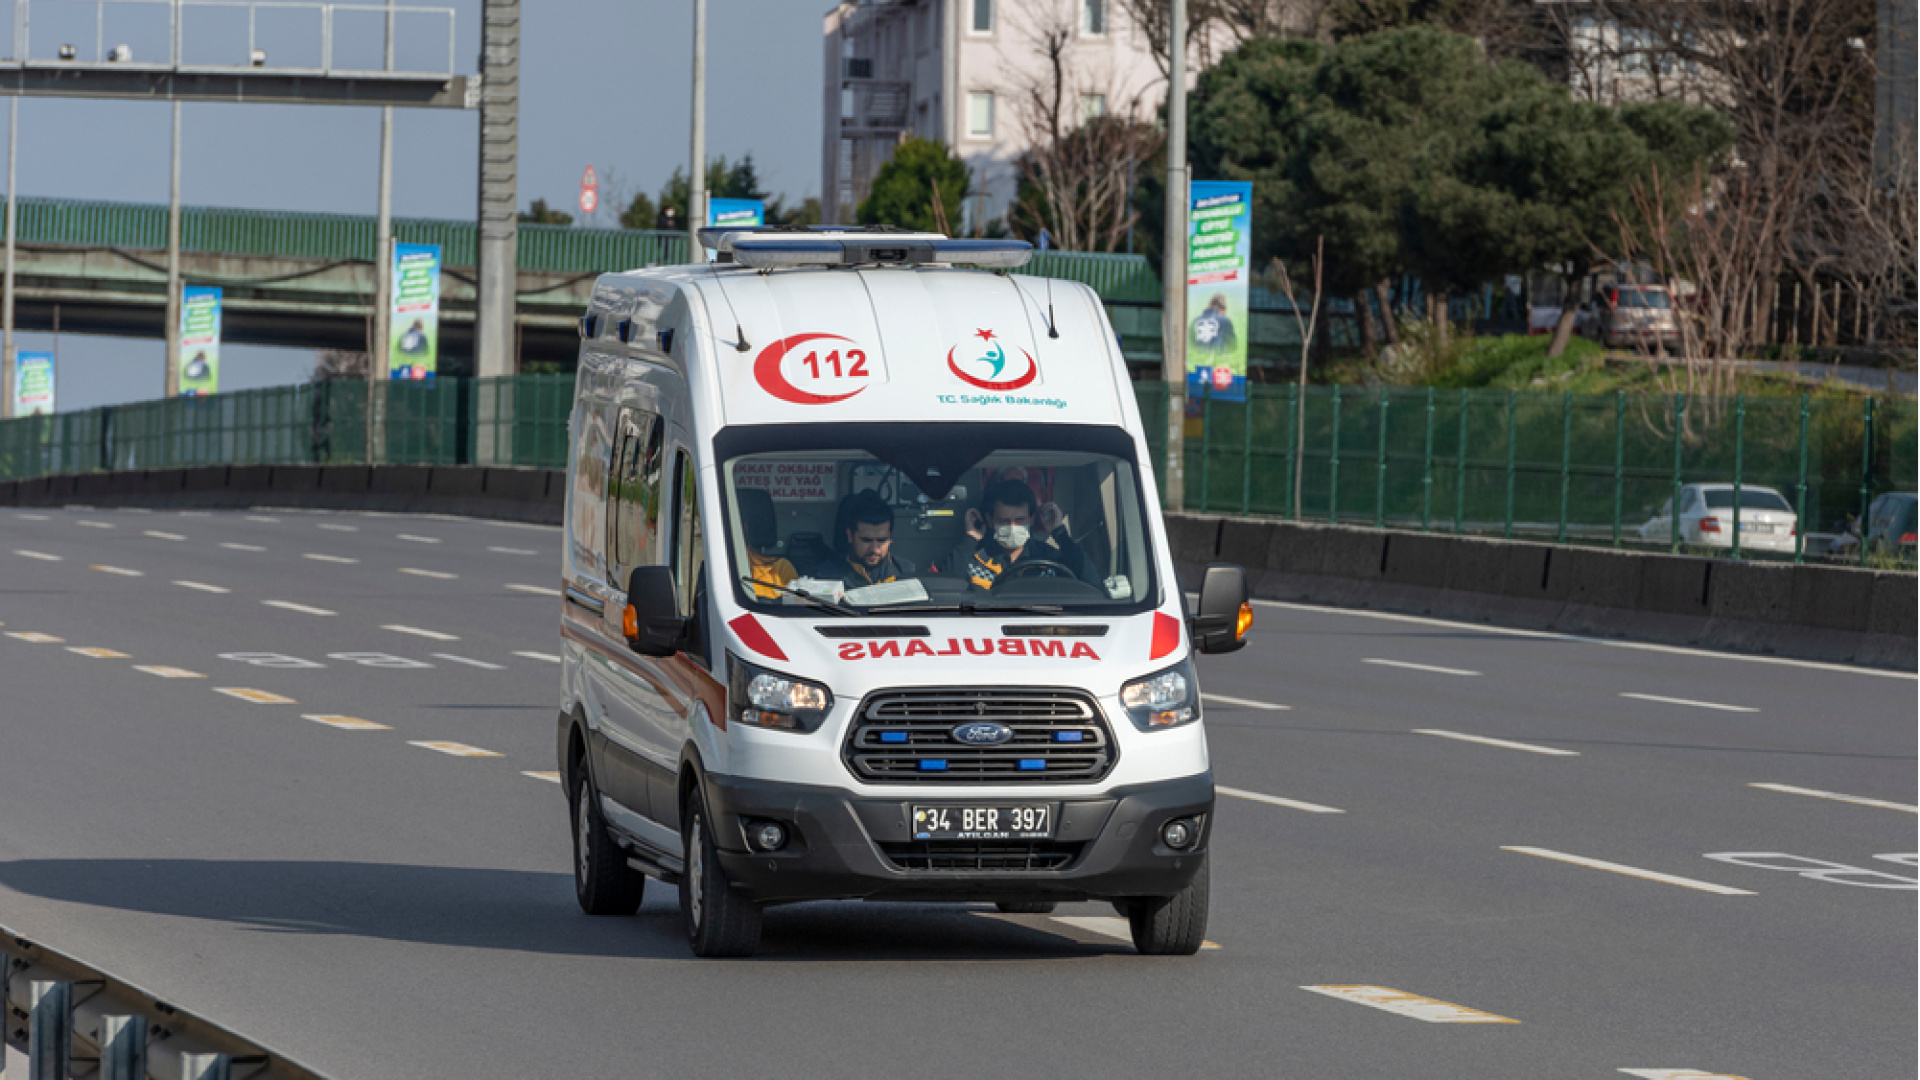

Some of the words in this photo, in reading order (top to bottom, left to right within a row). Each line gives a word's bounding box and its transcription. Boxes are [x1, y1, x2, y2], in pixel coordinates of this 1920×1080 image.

[802, 349, 869, 378] 112
[775, 475, 791, 486] VE
[966, 726, 999, 741] Ford
[927, 808, 951, 831] 34
[963, 808, 999, 831] BER
[1010, 807, 1047, 831] 397
